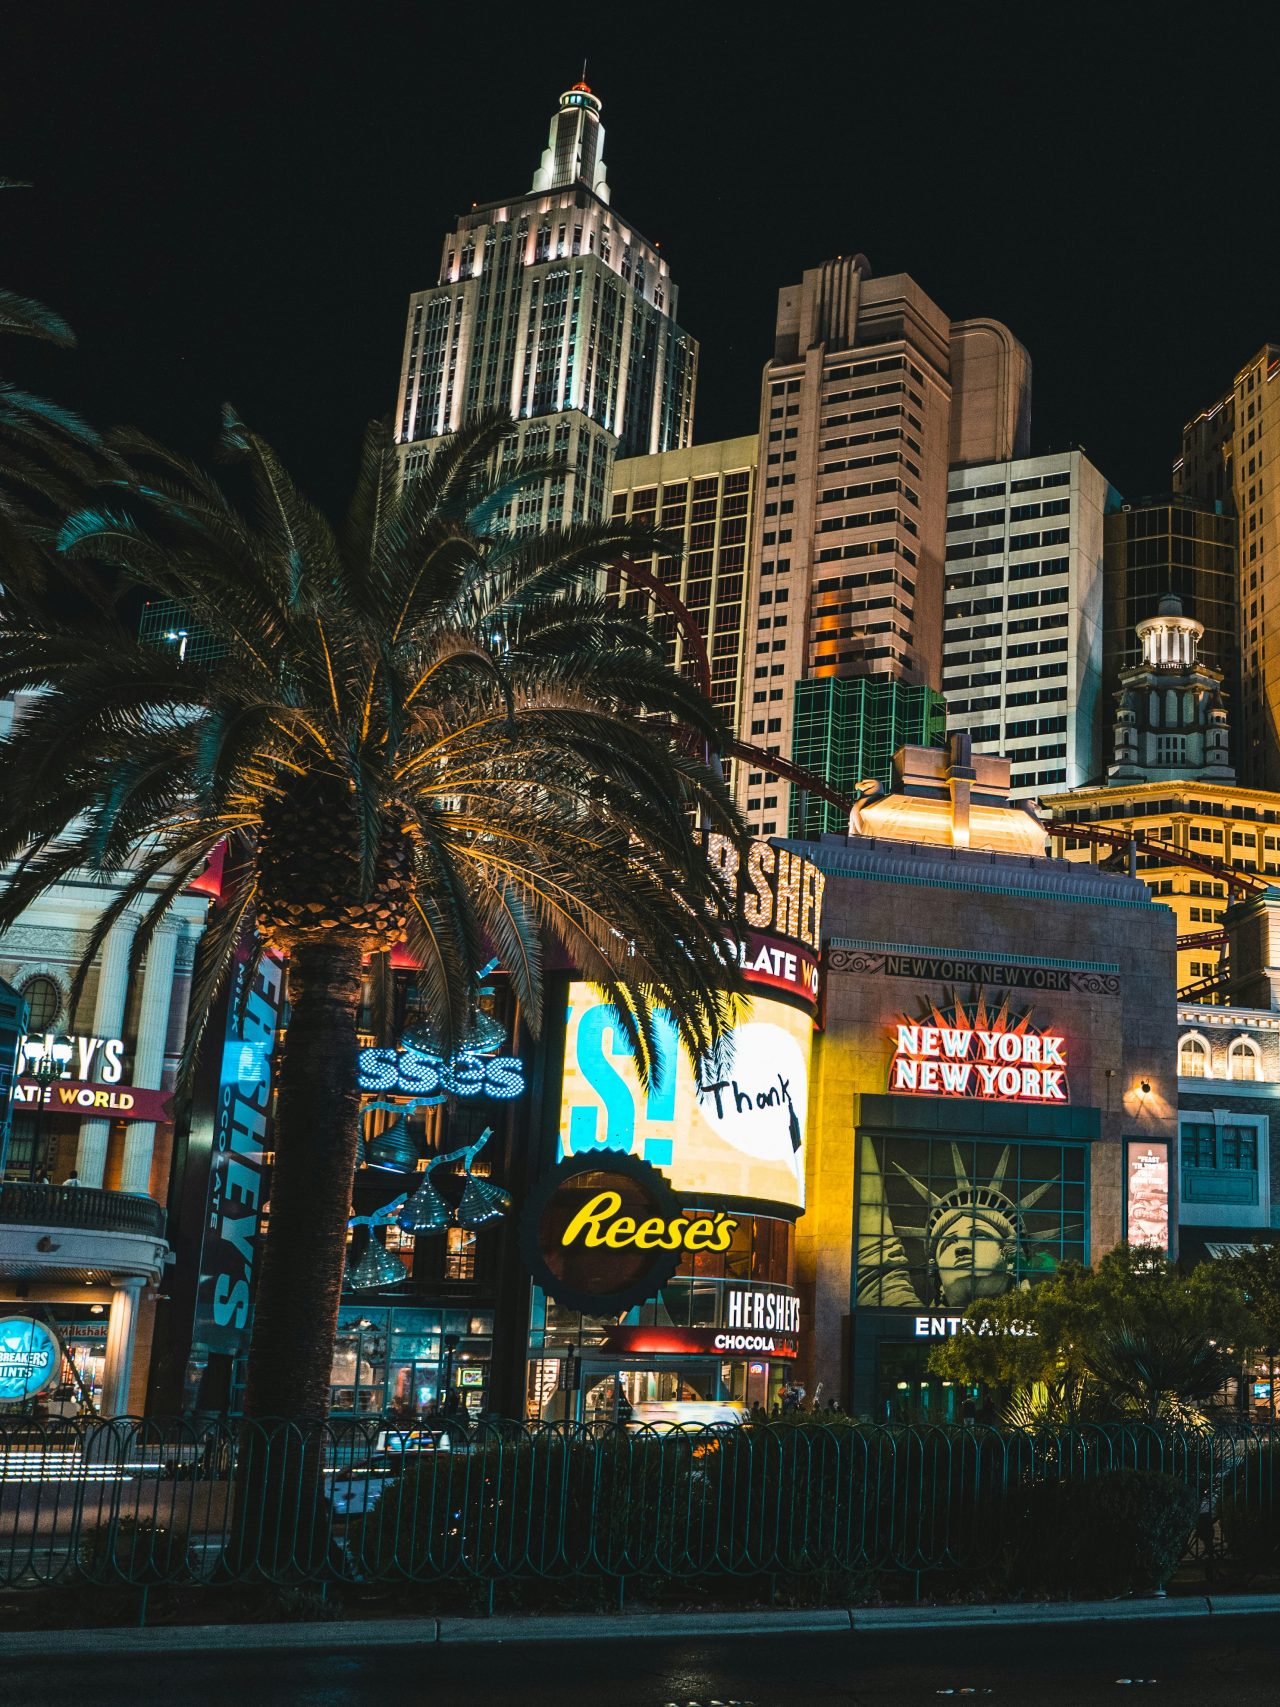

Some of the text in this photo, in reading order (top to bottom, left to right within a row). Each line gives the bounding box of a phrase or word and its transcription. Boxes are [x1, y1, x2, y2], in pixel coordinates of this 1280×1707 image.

[888, 958, 1069, 989] NEW YORK NEW YORK
[896, 1024, 1067, 1066] NEW YORK
[59, 1087, 134, 1110] WORLD
[700, 1073, 791, 1120] Thank
[895, 1059, 1067, 1099] NEW YORK
[210, 1085, 232, 1230] OCOLATE
[214, 950, 284, 1329] ERSHEY'S
[561, 1191, 738, 1251] Reese's
[60, 1325, 108, 1336] Milkshak
[0, 1367, 33, 1378] INTS
